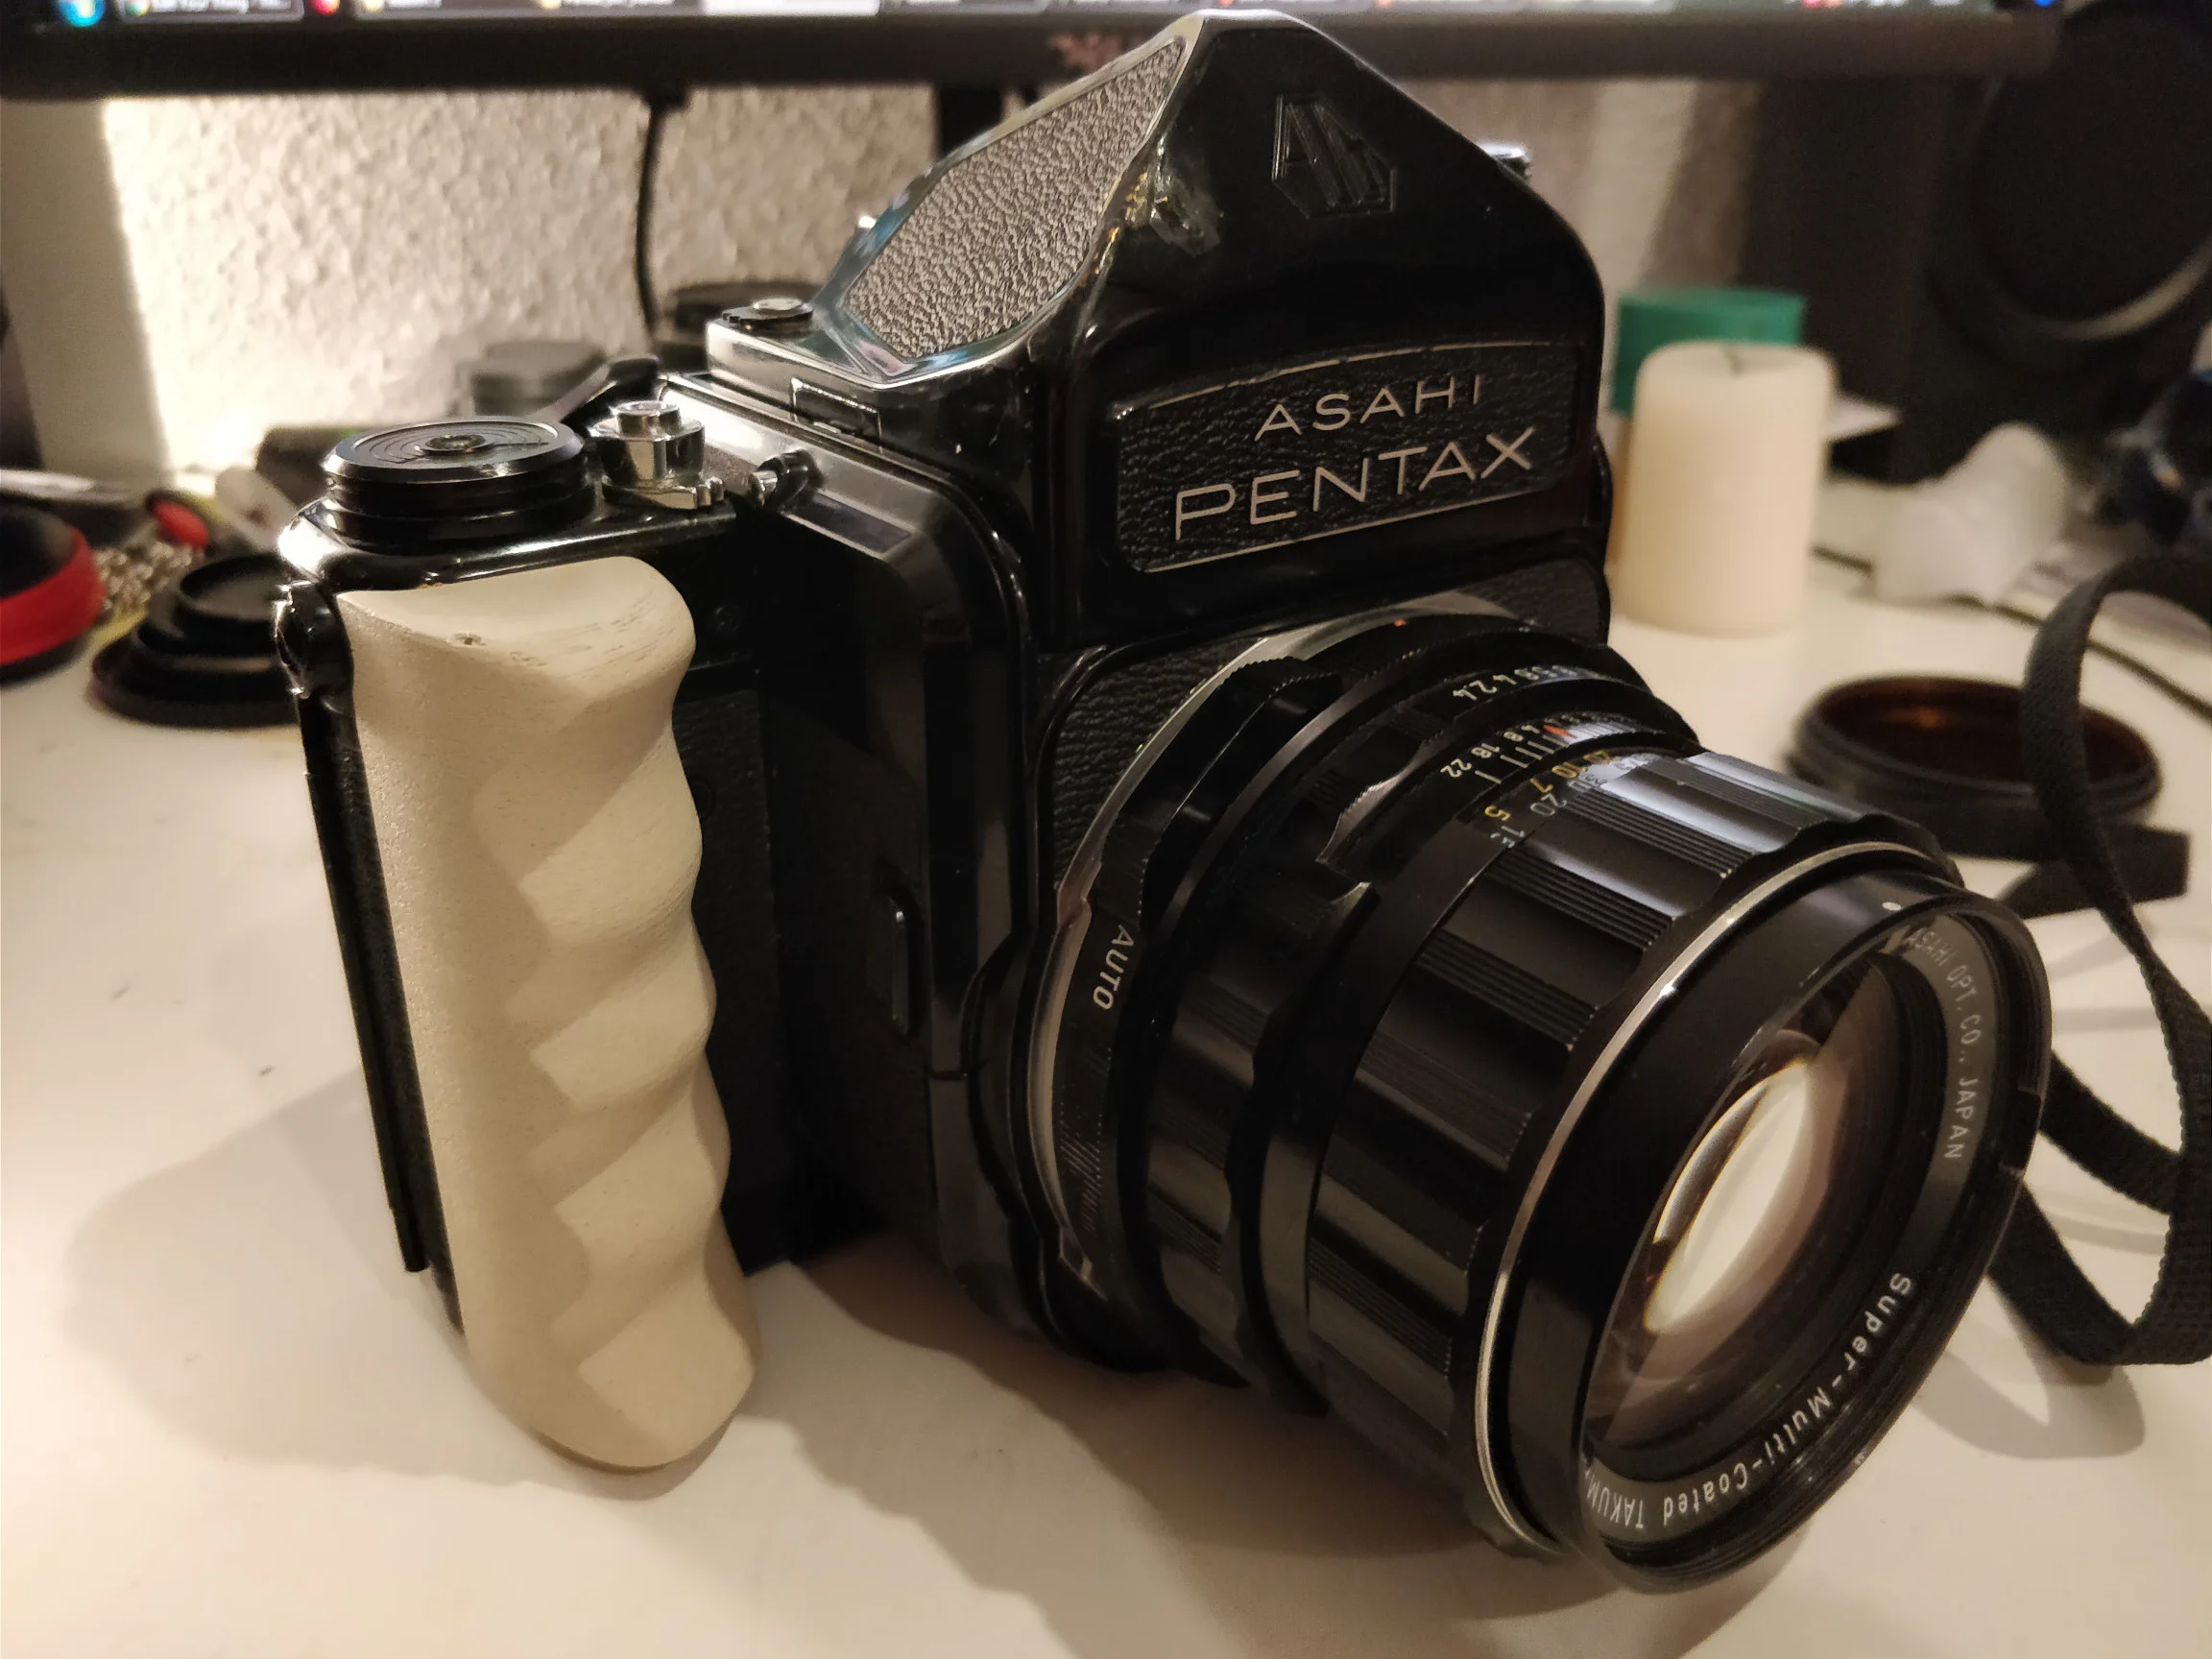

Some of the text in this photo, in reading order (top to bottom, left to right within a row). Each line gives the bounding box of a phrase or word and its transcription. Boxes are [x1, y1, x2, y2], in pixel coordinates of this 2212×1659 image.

[1254, 374, 1480, 442] ASAHI
[1174, 426, 1534, 541] PENTAX
[1440, 757, 1473, 778] 22
[1530, 778, 1553, 793] 7
[1551, 761, 1588, 779] 10
[1484, 805, 1511, 822] 5
[1529, 793, 1568, 816] 20
[1093, 924, 1135, 1010] AUTO
[1946, 964, 1977, 1011] OPT.
[1943, 1077, 1979, 1160] JAPAN
[1584, 1468, 1645, 1529] TAKUM
